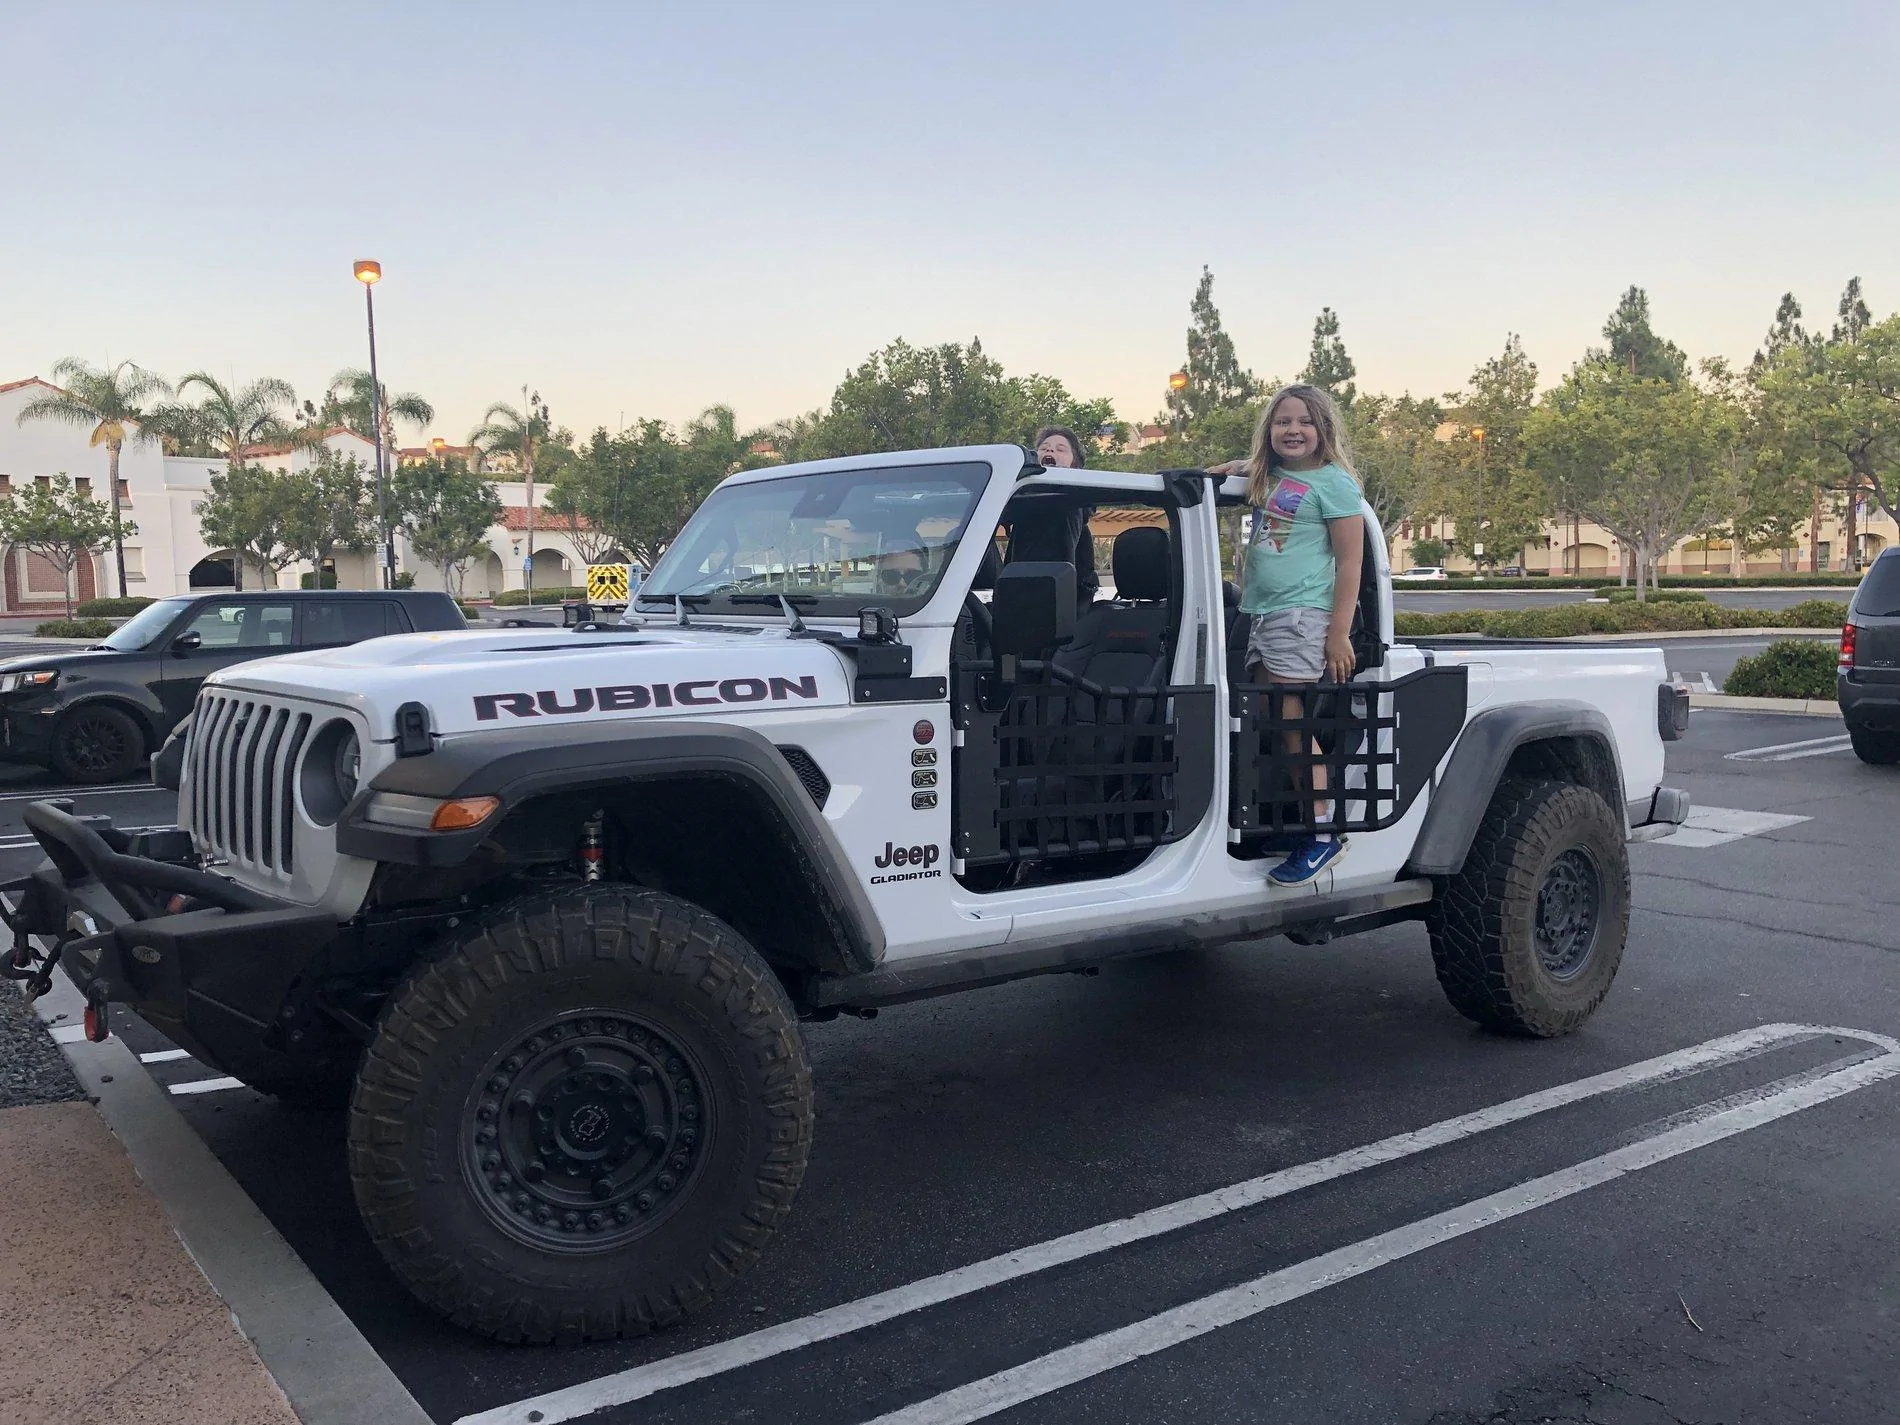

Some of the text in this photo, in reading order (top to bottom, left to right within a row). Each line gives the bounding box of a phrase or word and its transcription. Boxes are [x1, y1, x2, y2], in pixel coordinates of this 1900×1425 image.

[473, 675, 819, 721] RUBICON
[874, 842, 940, 869] Jeep
[870, 869, 942, 885] GLADIATOR
